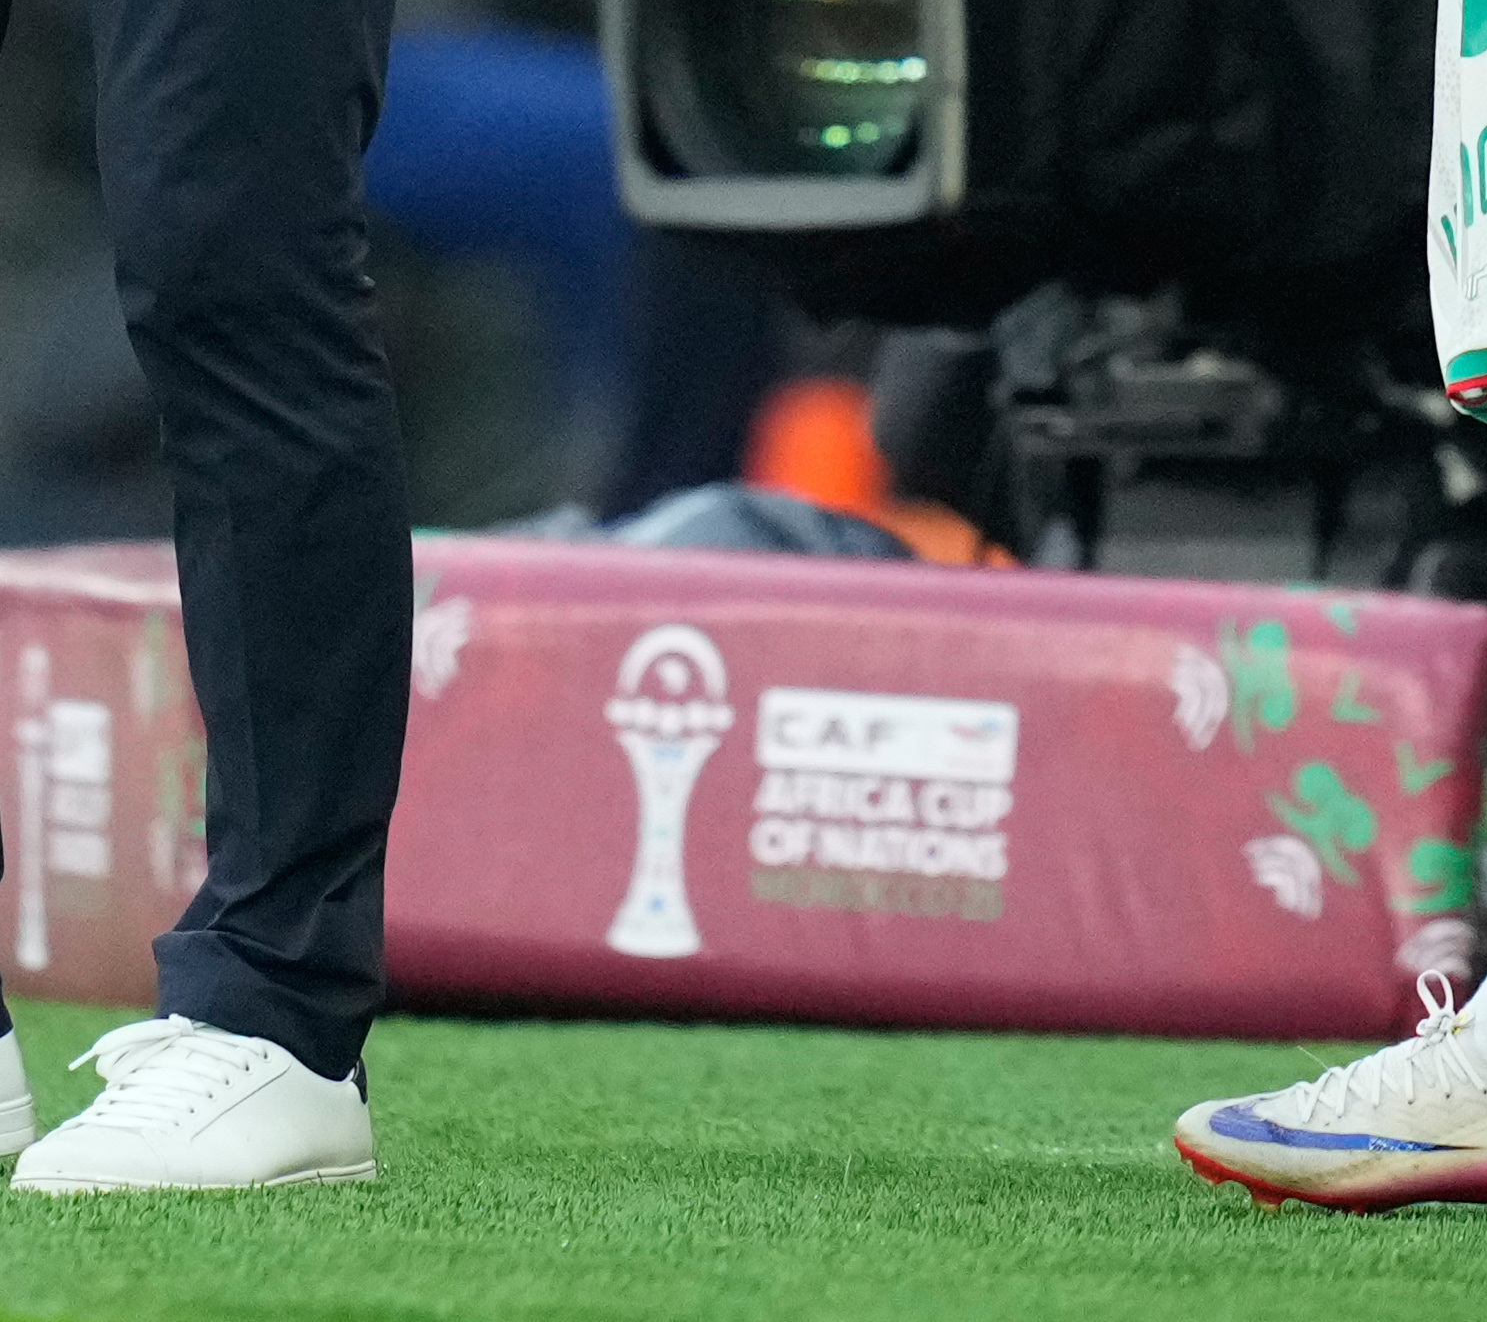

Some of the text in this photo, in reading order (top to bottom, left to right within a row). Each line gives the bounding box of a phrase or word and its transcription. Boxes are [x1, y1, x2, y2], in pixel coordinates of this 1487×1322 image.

[773, 709, 894, 749] CAF
[918, 779, 1014, 829] CUP
[748, 818, 814, 867] OF
